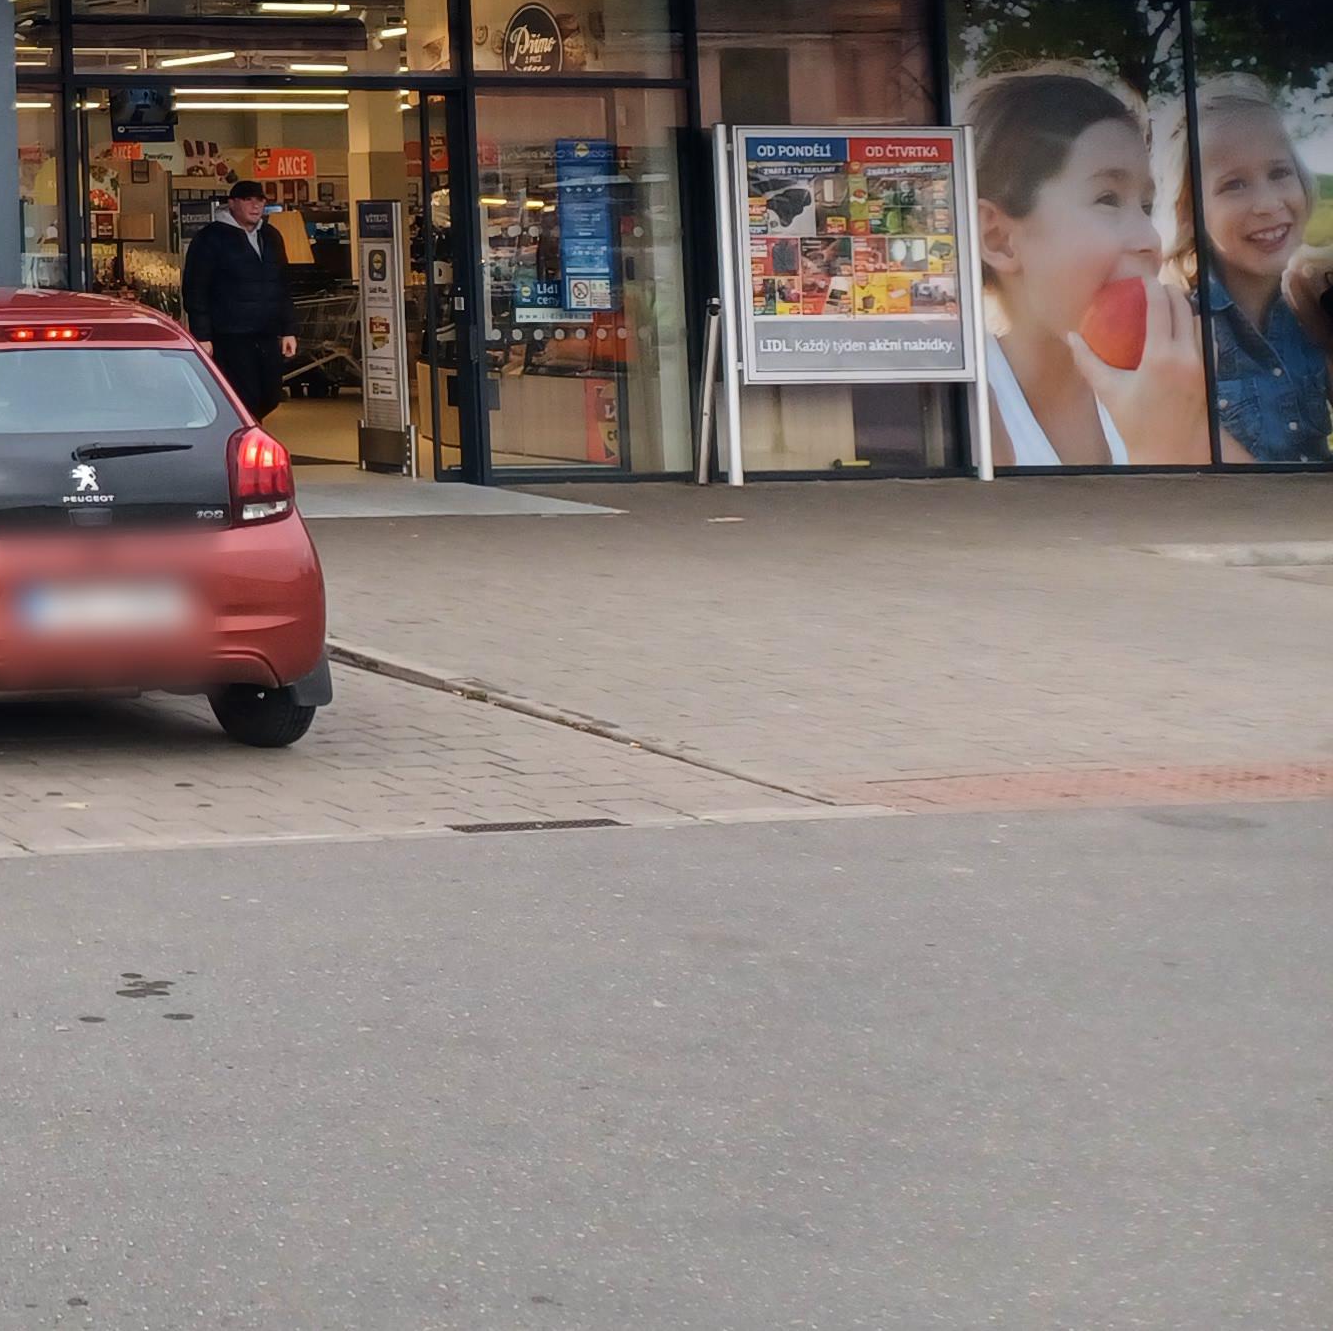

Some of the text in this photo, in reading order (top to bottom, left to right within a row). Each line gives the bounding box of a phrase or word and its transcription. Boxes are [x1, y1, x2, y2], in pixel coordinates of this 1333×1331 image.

[757, 144, 775, 157] OD
[865, 143, 939, 157] OD ČTVRTKA
[278, 156, 307, 175] AKCE
[795, 340, 830, 354] Každý
[834, 340, 867, 354] týden
[869, 340, 901, 352] akční
[63, 495, 115, 503] PEUGEOT
[196, 510, 224, 519] 108
